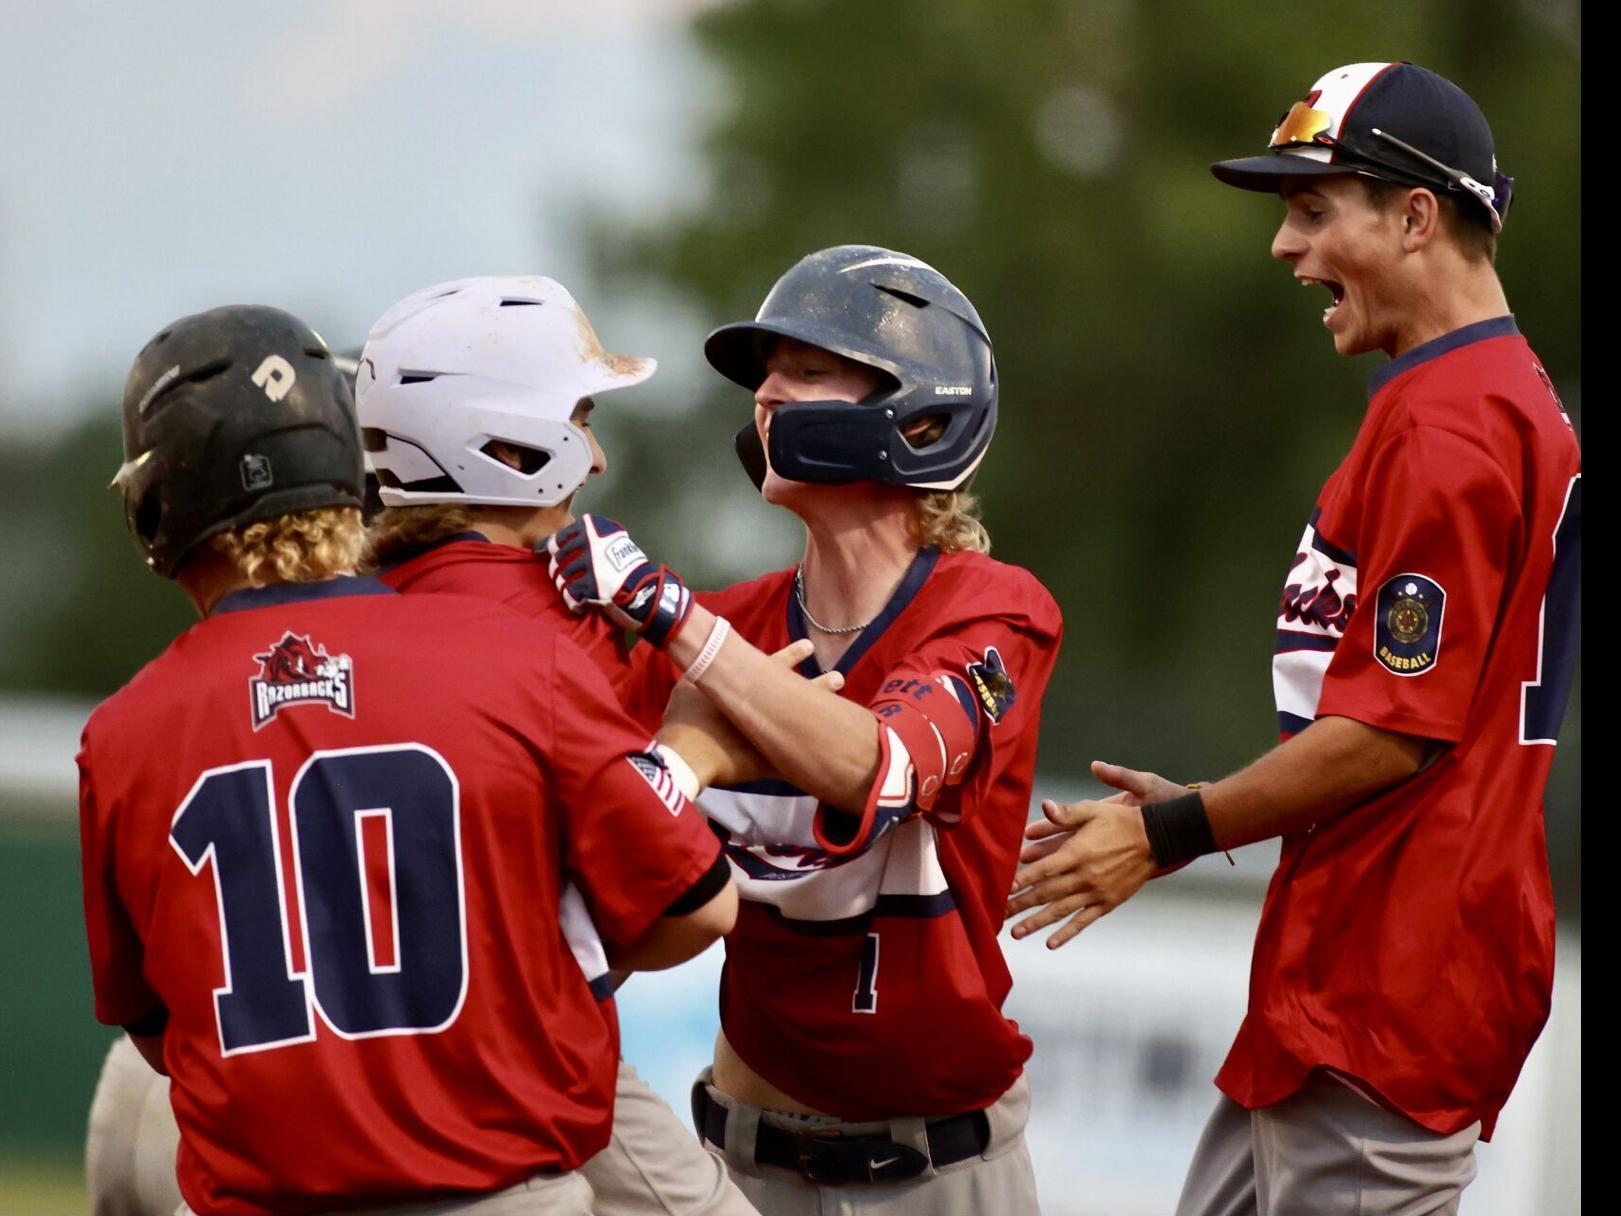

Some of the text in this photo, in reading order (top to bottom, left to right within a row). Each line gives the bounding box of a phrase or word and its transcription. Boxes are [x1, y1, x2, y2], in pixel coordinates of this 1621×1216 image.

[935, 386, 972, 396] EASTON
[1379, 645, 1432, 670] BASEBALL
[256, 671, 348, 720] RAZORBACKS
[168, 741, 469, 1058] 10
[851, 932, 880, 1014] 1
